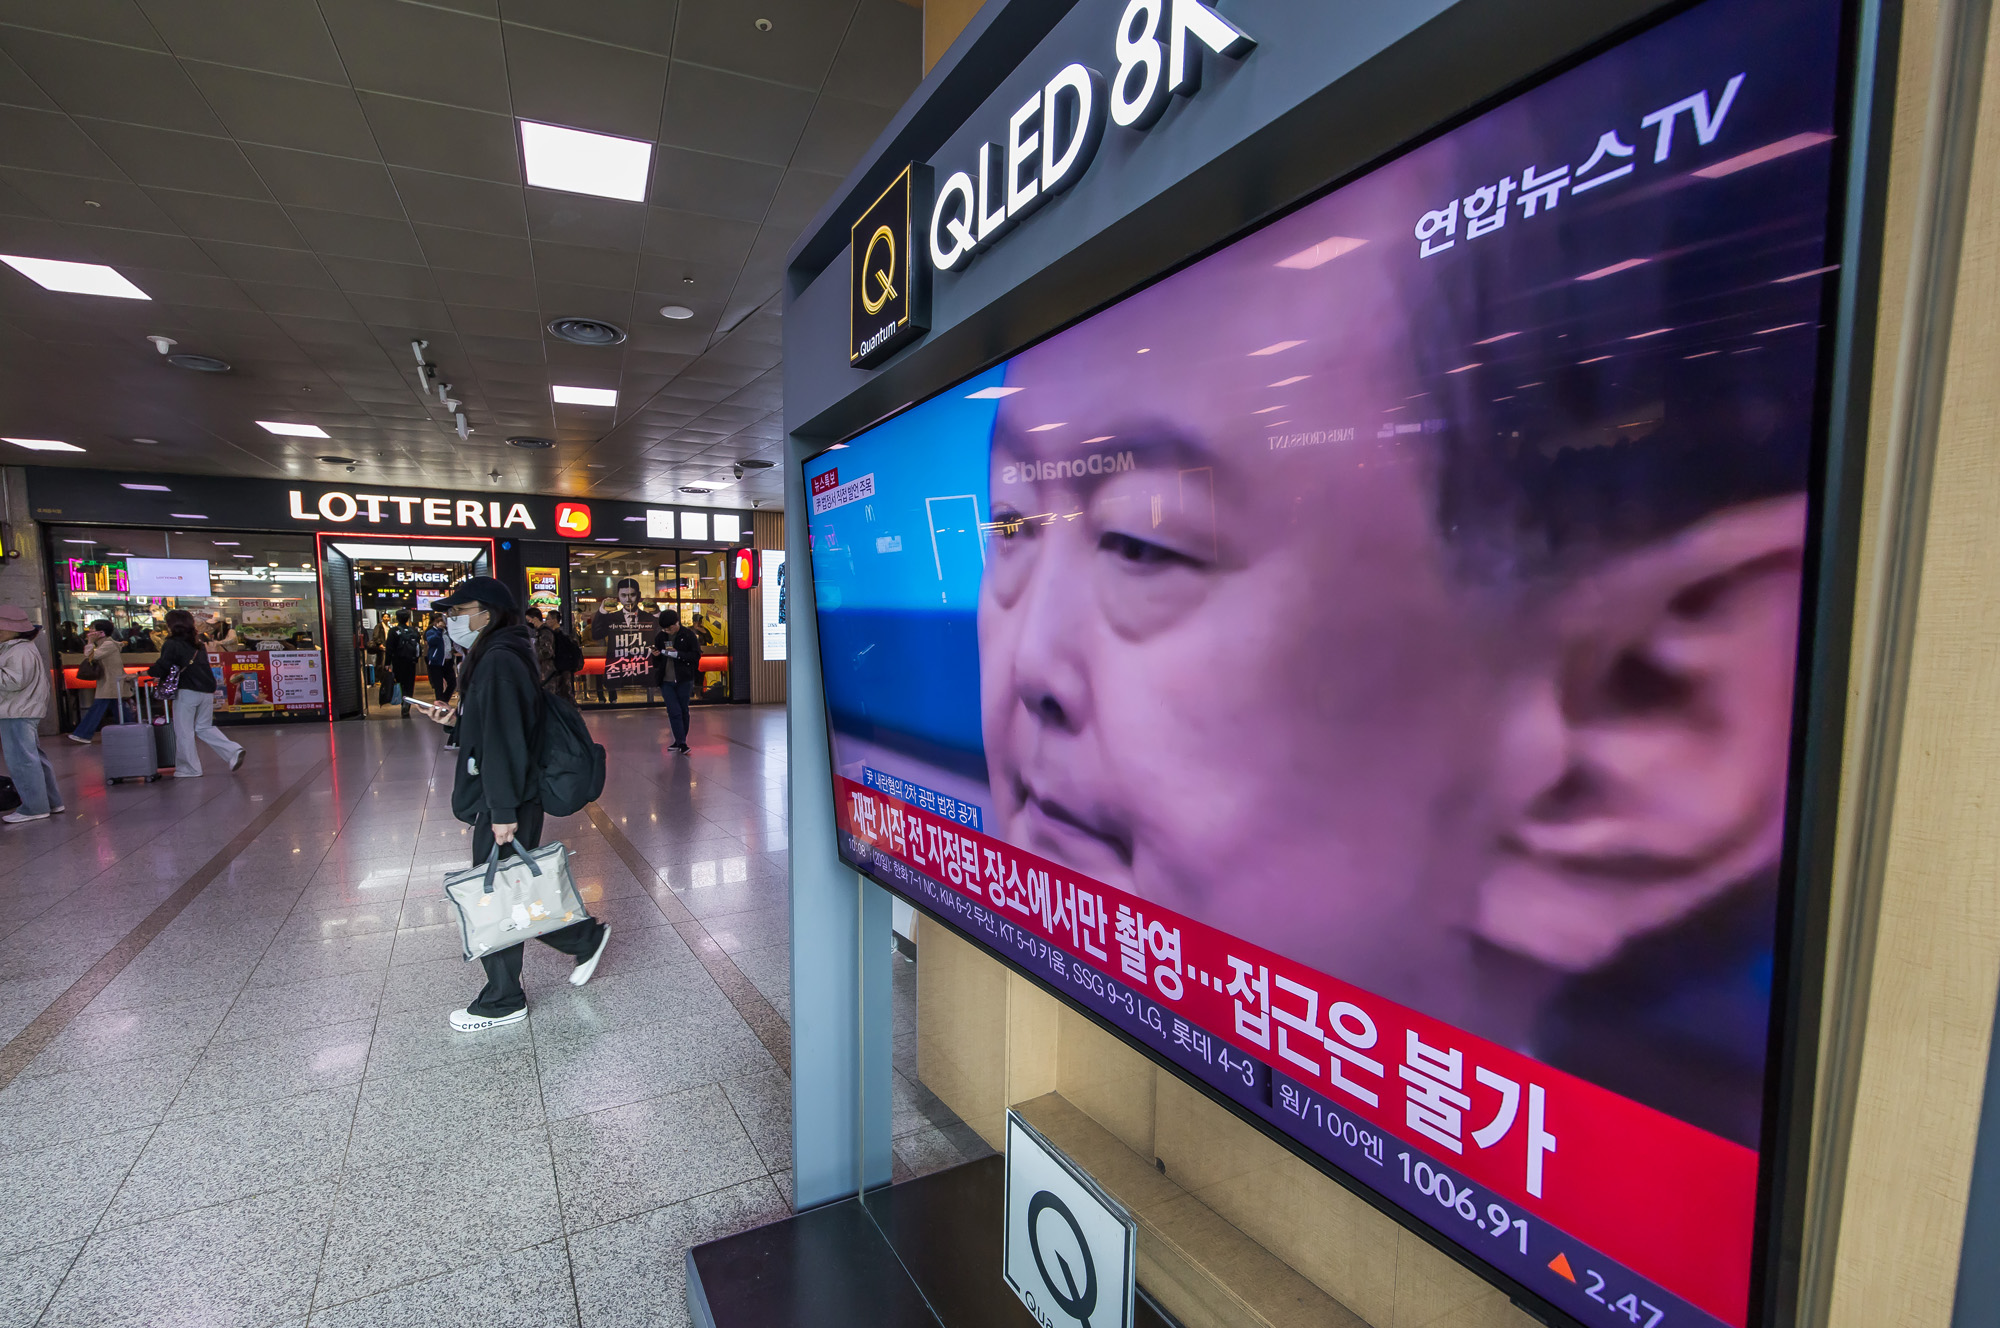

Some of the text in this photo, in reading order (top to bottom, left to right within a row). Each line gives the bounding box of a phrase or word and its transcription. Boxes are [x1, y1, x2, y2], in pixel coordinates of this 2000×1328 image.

[929, 62, 1092, 270] QLED
[859, 320, 897, 357] Quantum
[814, 471, 836, 493] 뉴스특보
[288, 490, 536, 530] LOTTERIA
[263, 600, 298, 609] Burger!
[615, 632, 647, 647] 버거,
[606, 664, 621, 679] 손
[904, 783, 917, 804] 2차
[918, 788, 936, 811] 공판
[937, 795, 956, 820] 법정
[958, 802, 978, 828] 공개
[893, 860, 909, 884] 한화
[939, 887, 955, 909] KIA
[956, 896, 973, 920] 6-2
[973, 905, 998, 938] 두산,
[999, 920, 1015, 943] KT
[1017, 930, 1037, 957] 5-0
[1039, 942, 1070, 981] 키움,
[1072, 962, 1105, 998] SSG
[1107, 982, 1134, 1015] 9-3
[1138, 999, 1167, 1040] LG,
[1172, 1017, 1212, 1065] 롯데
[1217, 1047, 1255, 1087] 4-3
[851, 792, 878, 841] 재판
[879, 803, 907, 857] 시작
[907, 814, 926, 866] 전
[926, 824, 982, 896] 지정된
[983, 847, 1108, 963] 장소에서만
[1398, 1028, 1557, 1199] 불가
[461, 1019, 493, 1030] crocs
[1279, 1083, 1664, 1328] 원/100엔 1006.91 2.47
